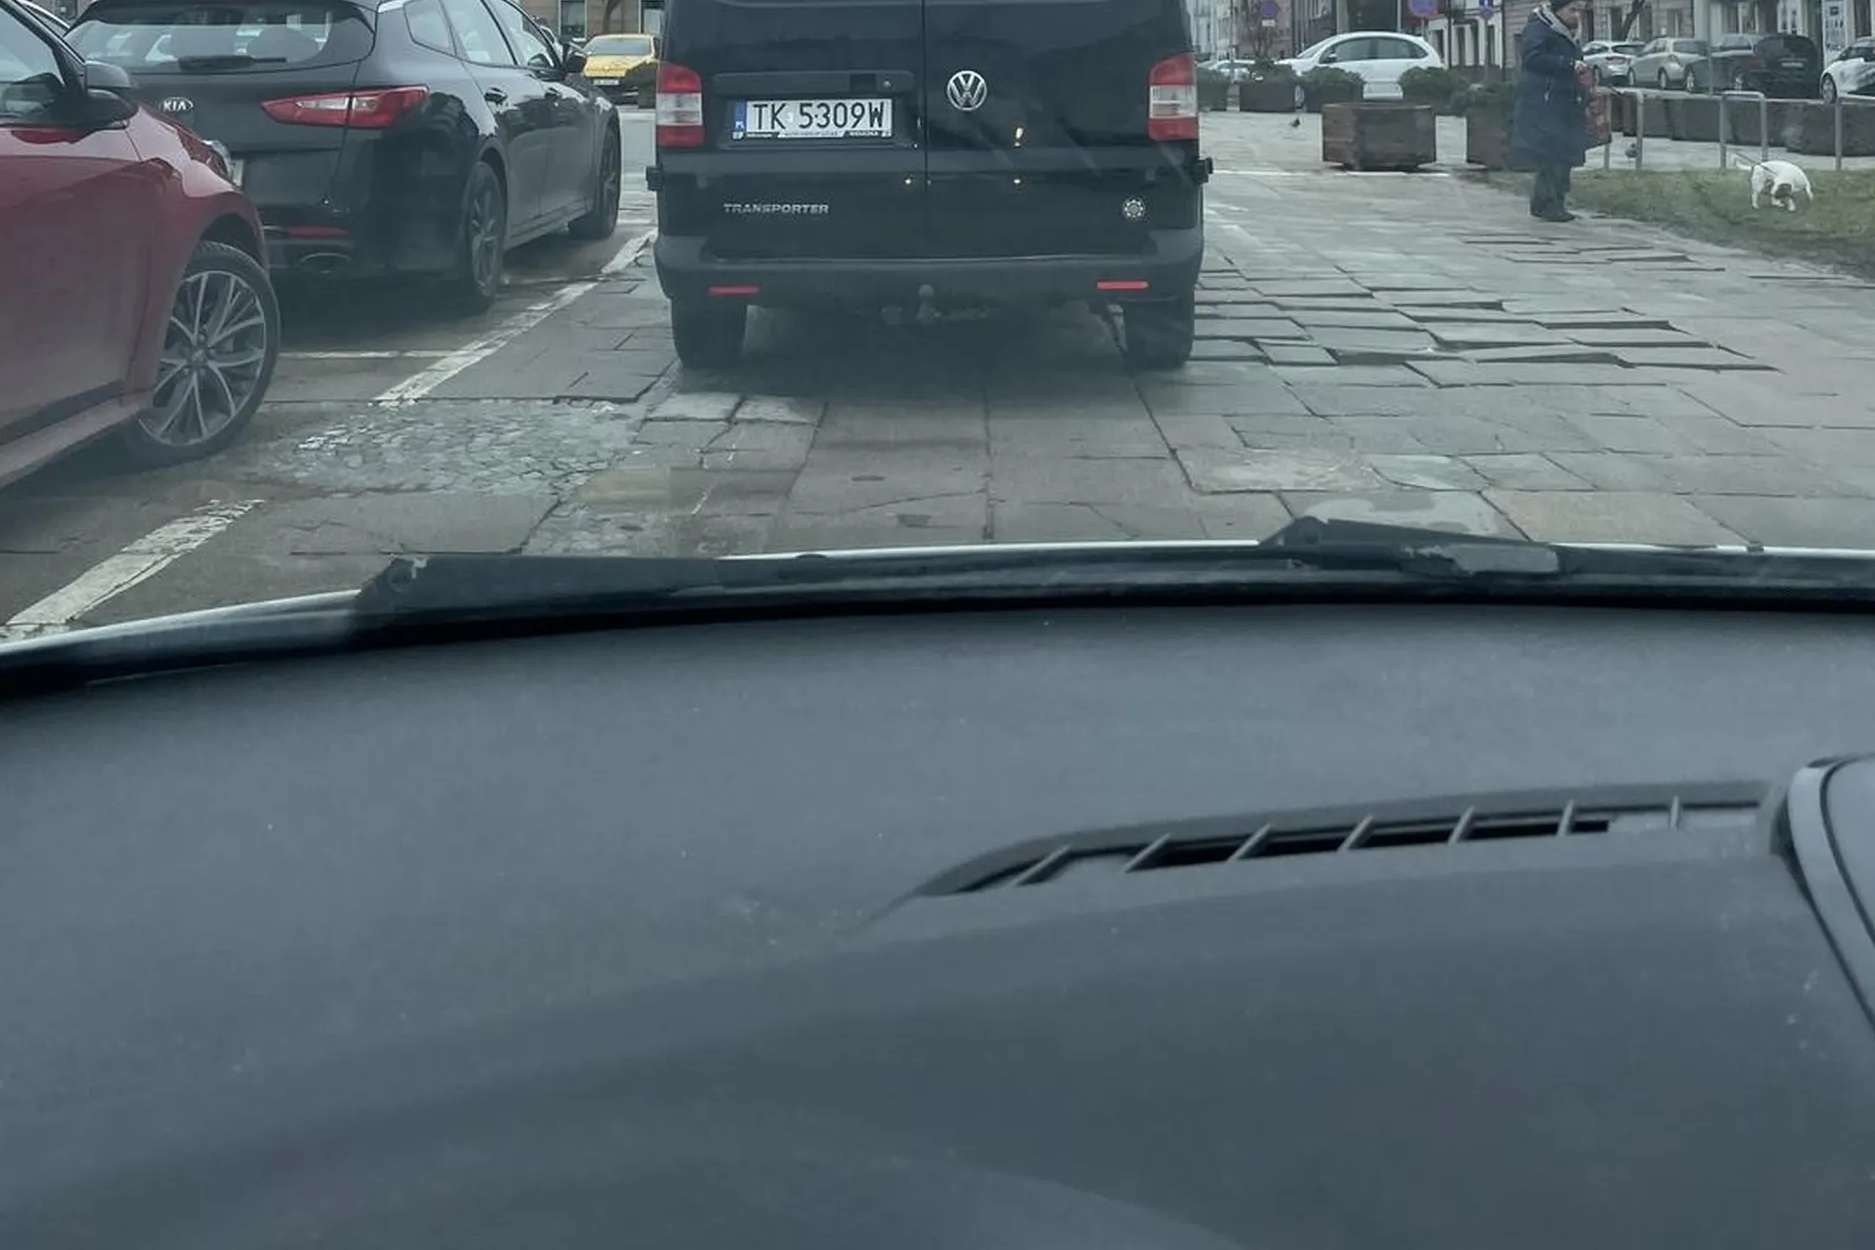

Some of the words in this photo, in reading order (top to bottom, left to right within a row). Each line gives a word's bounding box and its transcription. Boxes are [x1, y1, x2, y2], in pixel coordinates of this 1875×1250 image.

[163, 99, 188, 111] KIA
[753, 103, 787, 130] TK
[798, 101, 885, 129] 5309W
[723, 204, 830, 215] TRANSPORTER
